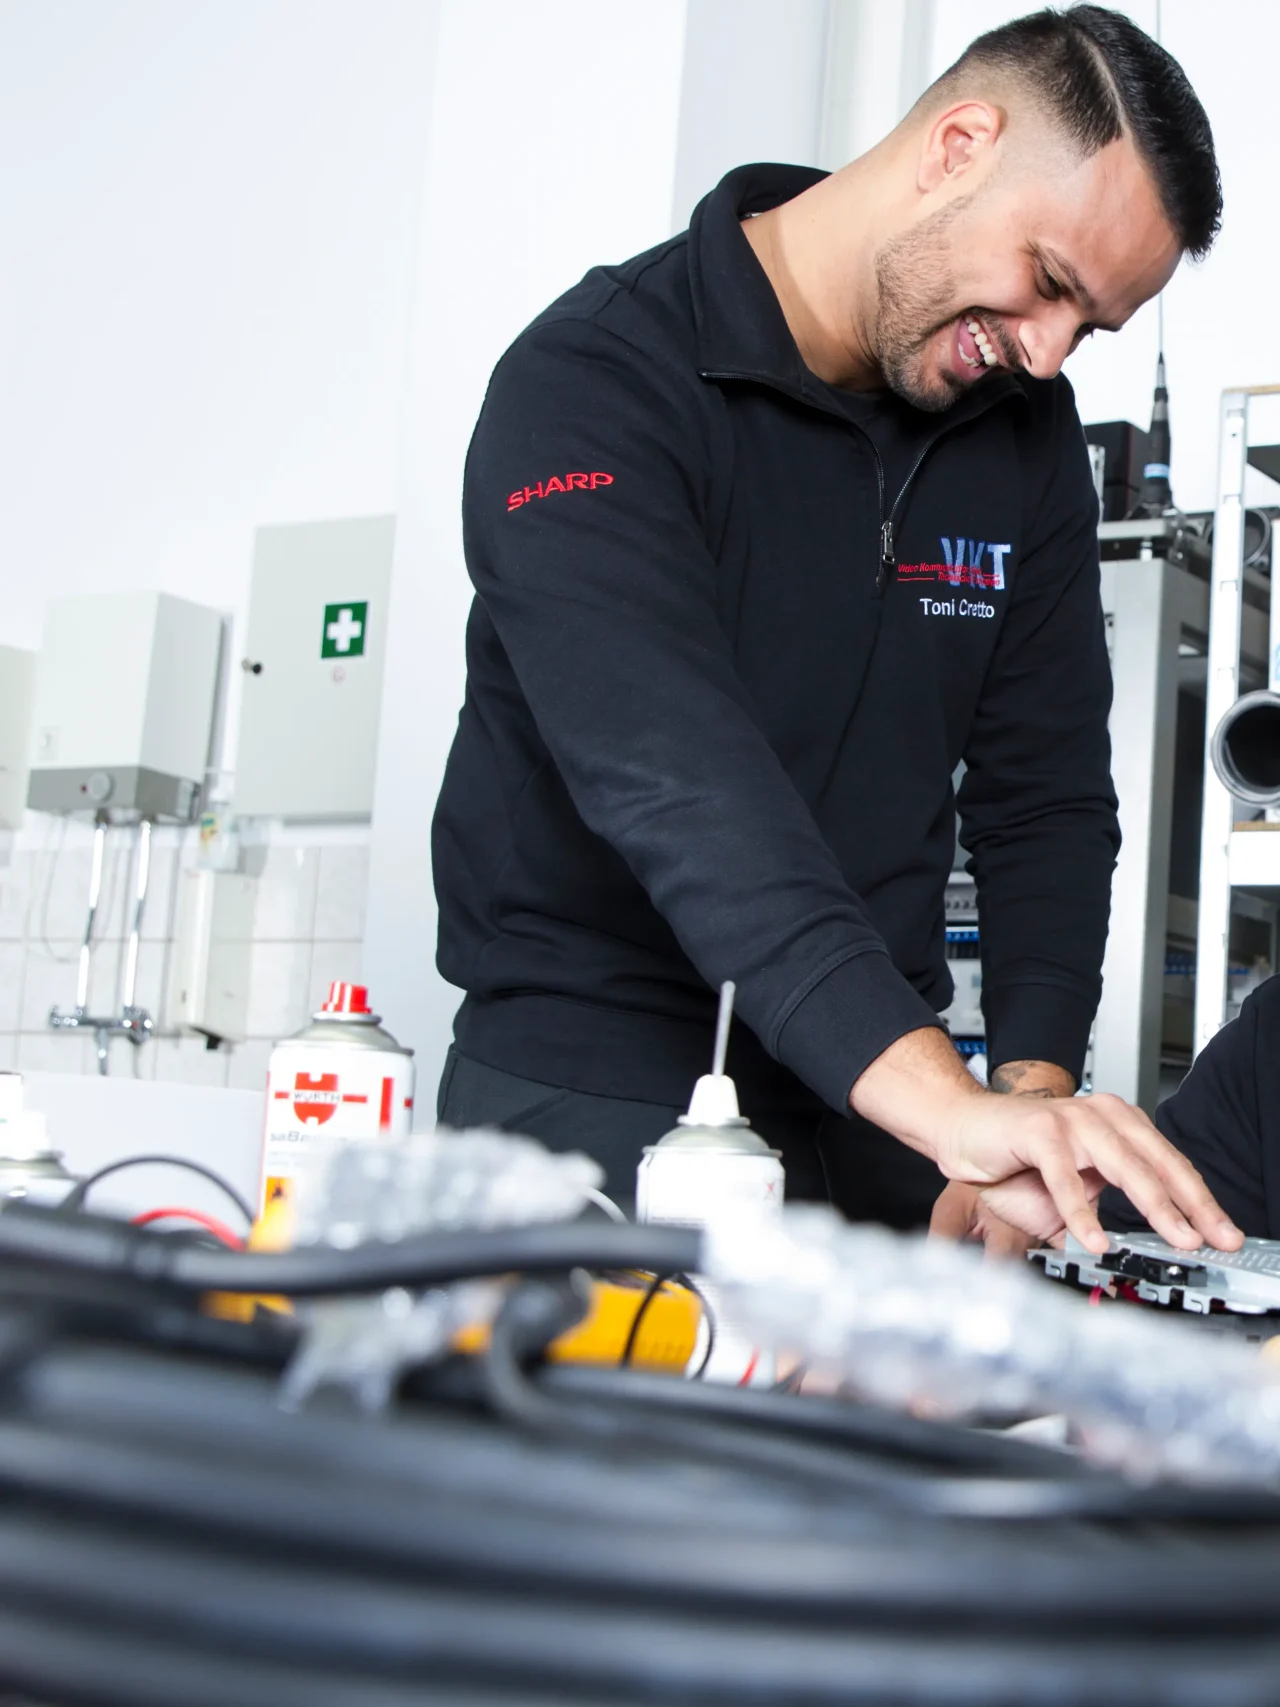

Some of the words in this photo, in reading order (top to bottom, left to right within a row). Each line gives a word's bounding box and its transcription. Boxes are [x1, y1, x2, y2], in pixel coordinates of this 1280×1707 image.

[507, 472, 614, 512] SHARP
[940, 537, 1011, 590] VKT
[919, 598, 955, 616] Toni
[959, 598, 995, 618] Cretto
